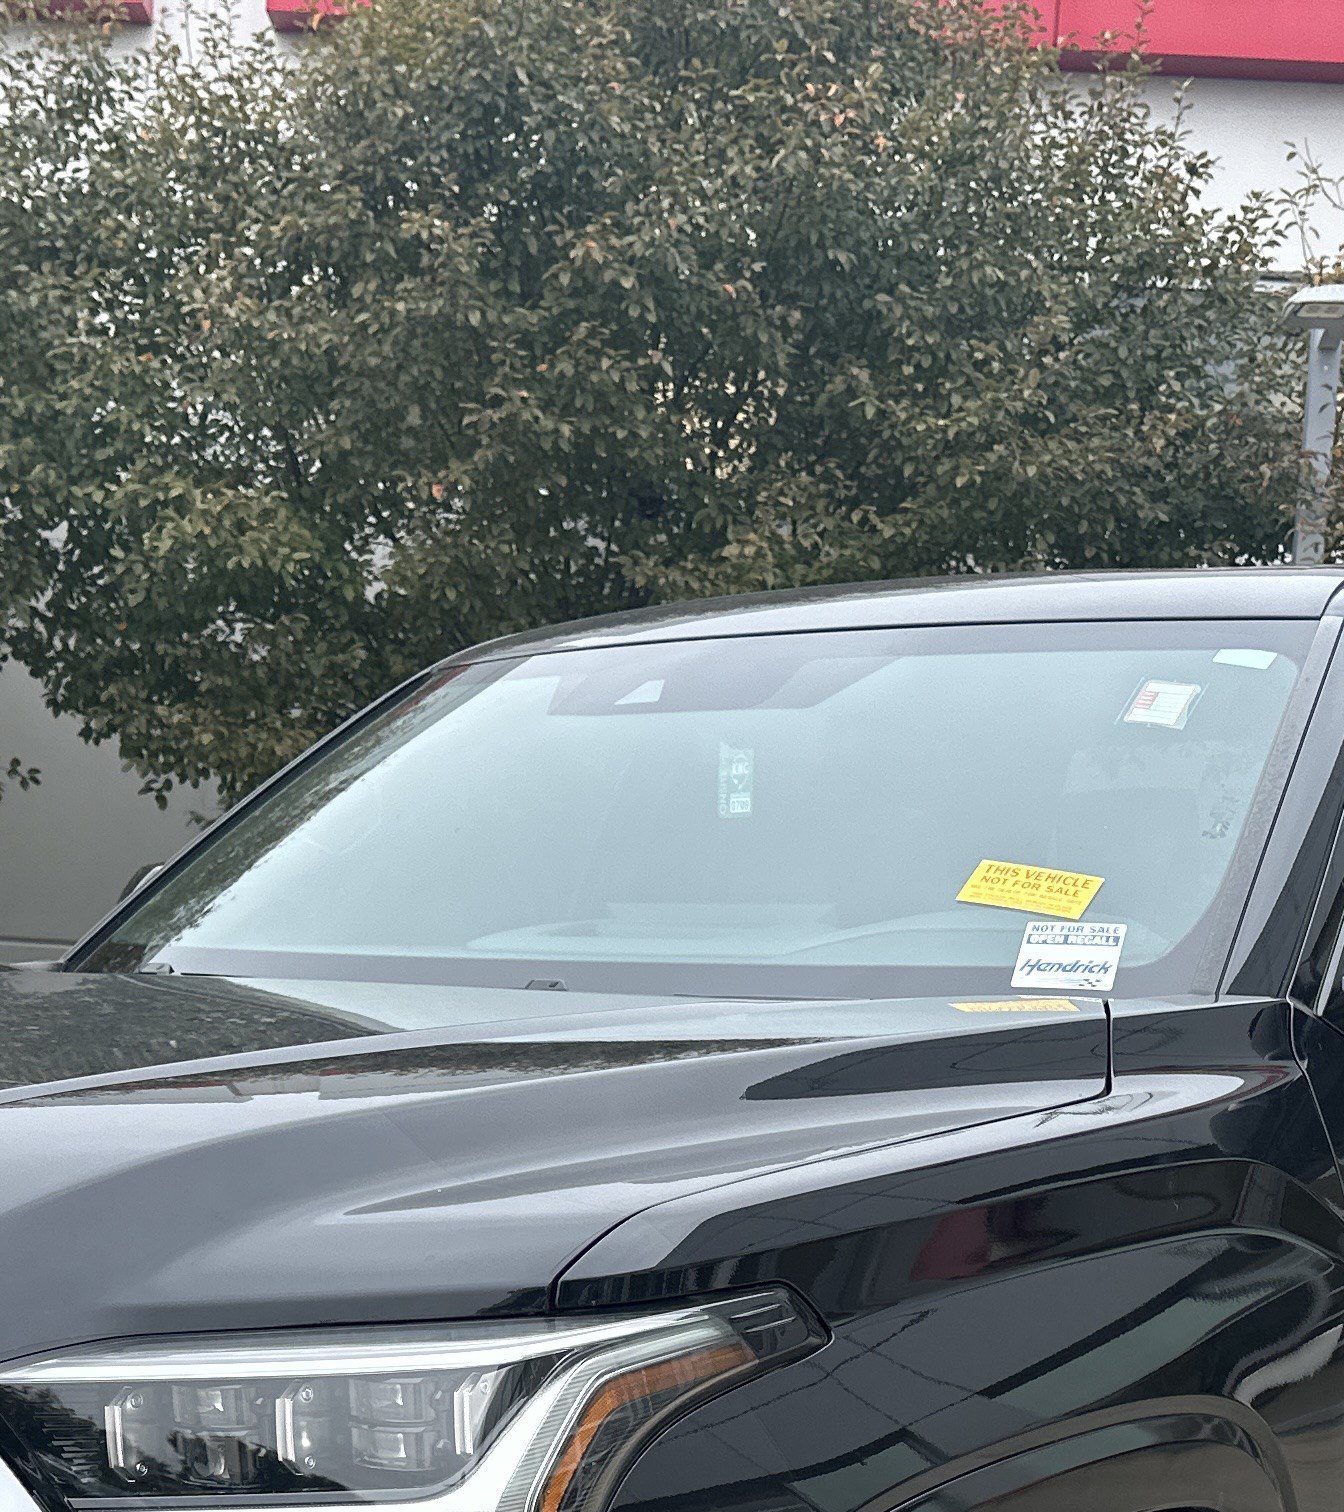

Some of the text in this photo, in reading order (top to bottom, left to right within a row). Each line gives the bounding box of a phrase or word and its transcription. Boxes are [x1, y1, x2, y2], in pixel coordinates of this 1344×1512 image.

[984, 864, 1094, 889] THIS VEHICLE
[980, 875, 1008, 886] NOT
[1012, 880, 1041, 891] FOR
[1045, 885, 1082, 898] SALE
[1031, 924, 1121, 934] NOT FOR SALE
[1029, 934, 1118, 946] OPEN RECALL
[1019, 958, 1113, 977] Hendrick
